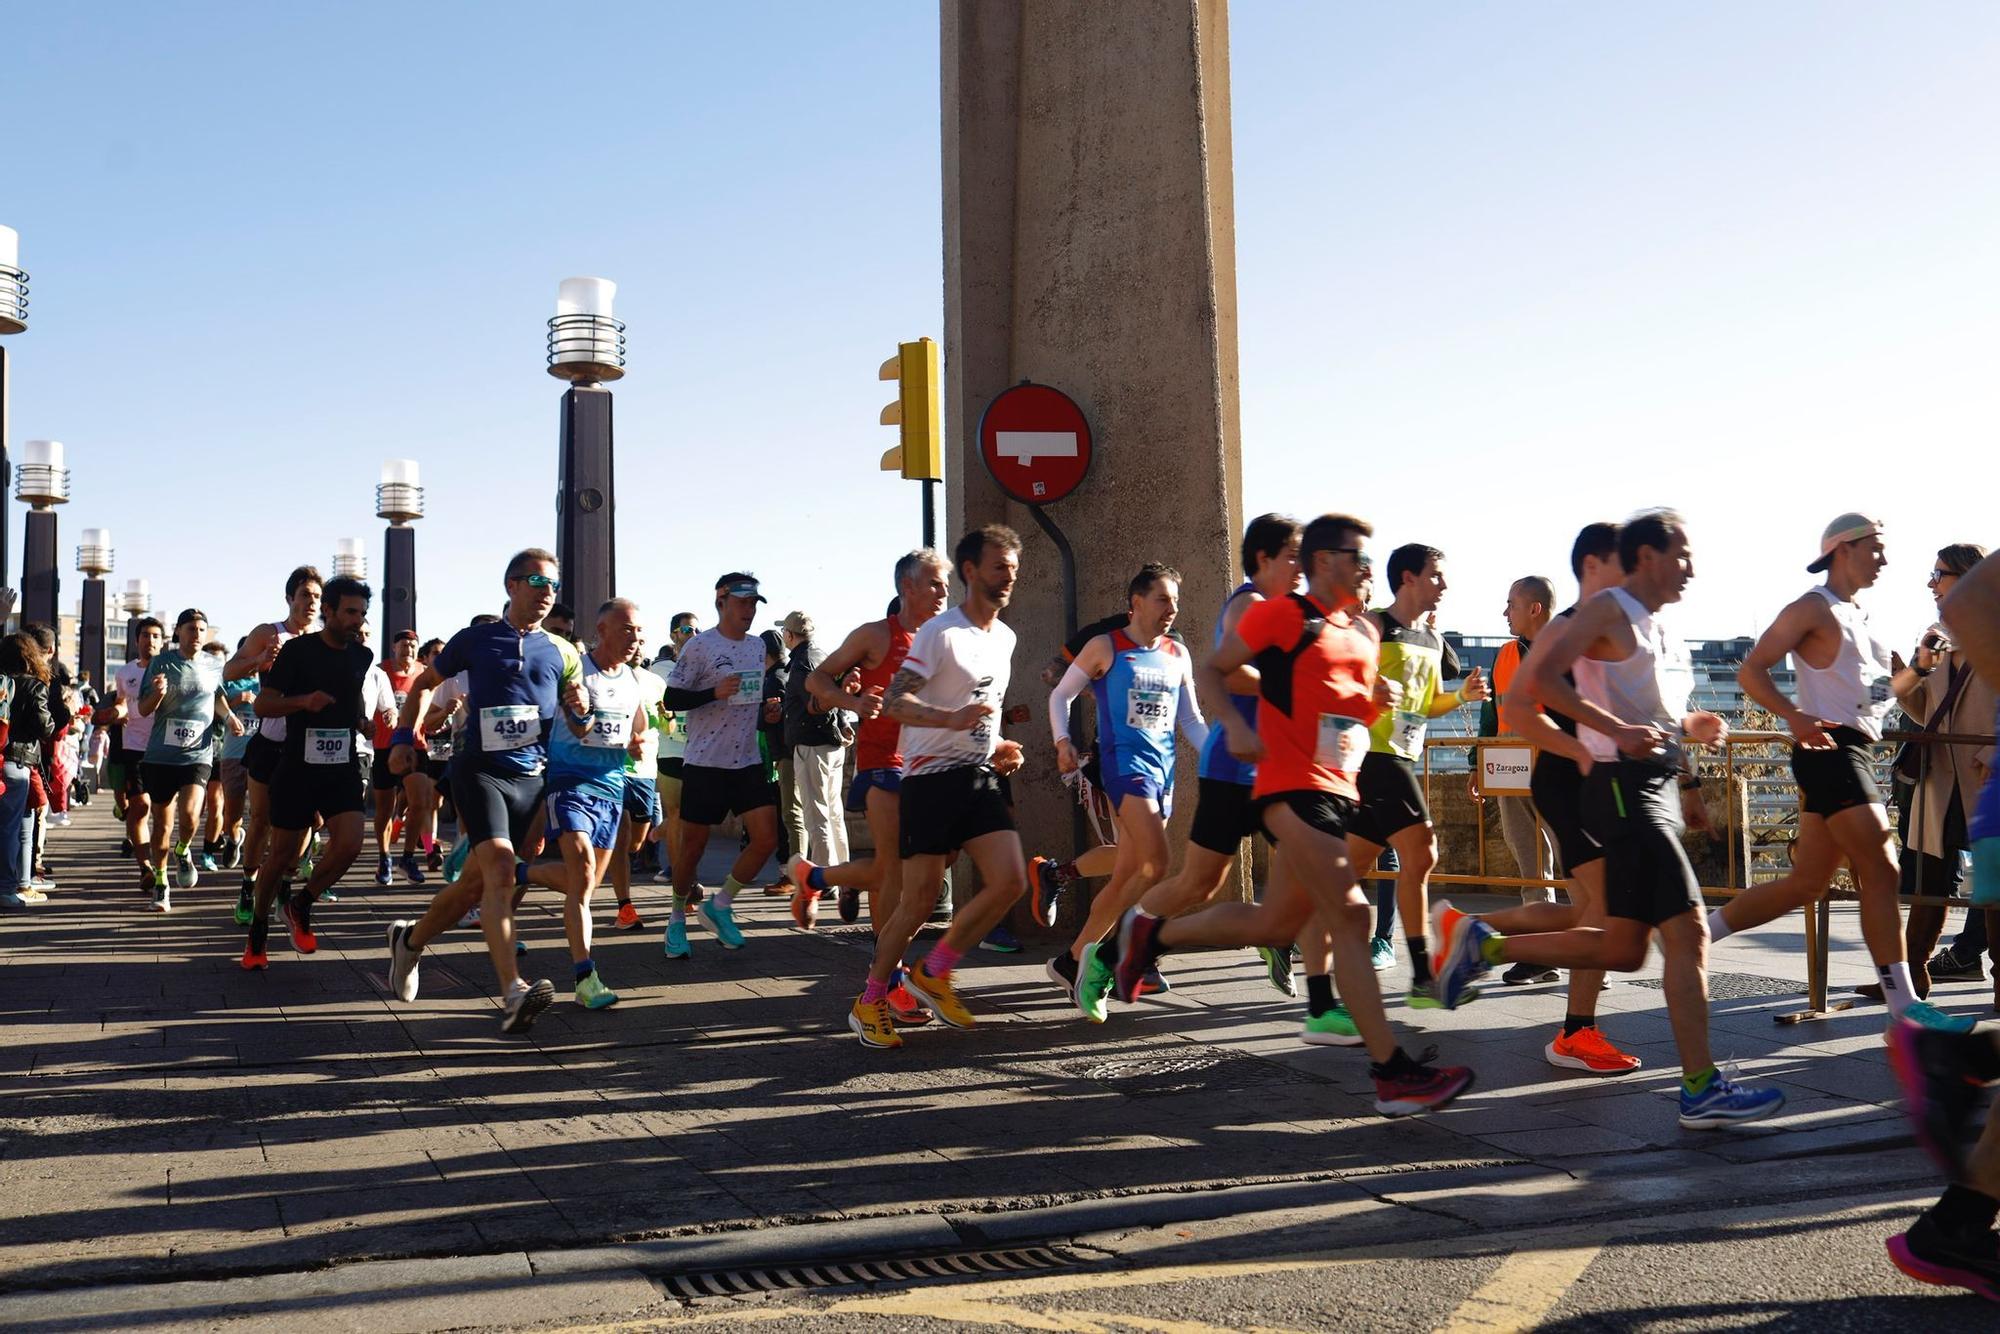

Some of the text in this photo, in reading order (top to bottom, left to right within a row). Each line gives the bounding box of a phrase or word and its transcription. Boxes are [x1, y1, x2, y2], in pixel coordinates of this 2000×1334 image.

[1135, 702, 1169, 718] 3253
[174, 728, 196, 738] 463
[494, 719, 528, 735] 430
[593, 721, 621, 735] 334
[316, 739, 343, 751] 300
[1496, 763, 1529, 775] Zaragoza
